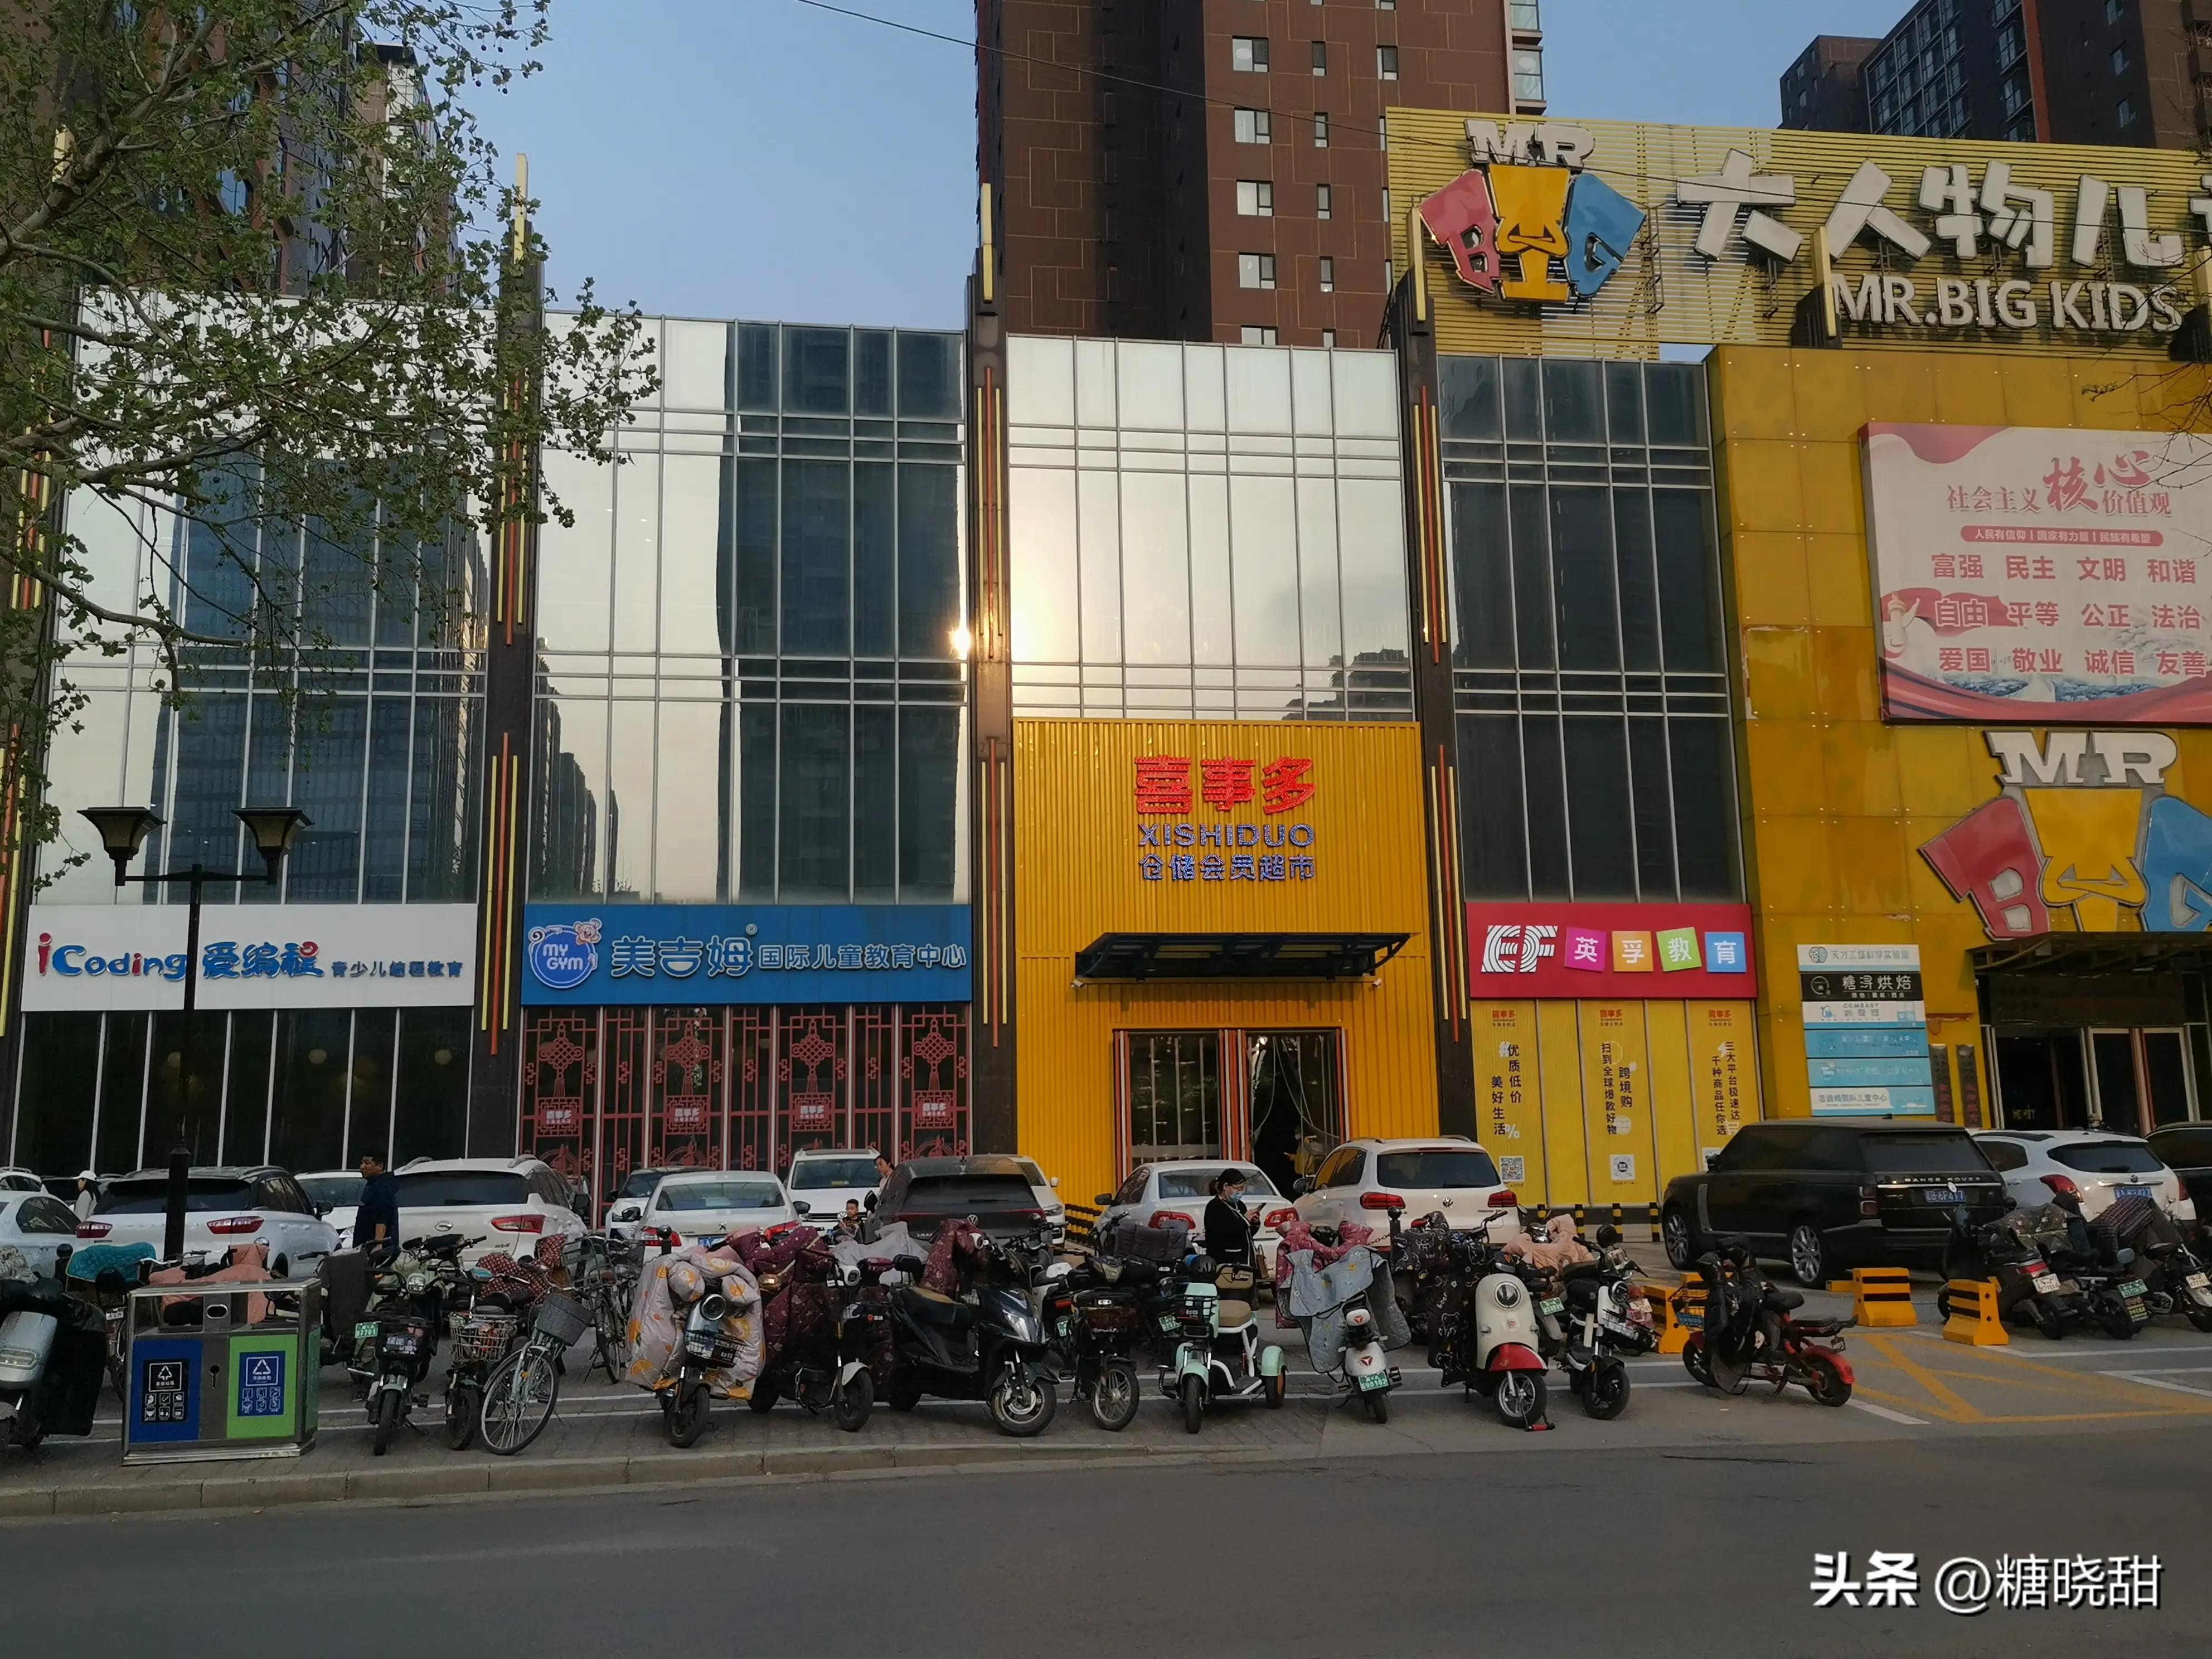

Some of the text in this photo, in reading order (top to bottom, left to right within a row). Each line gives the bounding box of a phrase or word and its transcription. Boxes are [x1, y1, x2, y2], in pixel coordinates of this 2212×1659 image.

[1464, 119, 1595, 171] MR
[1676, 148, 2212, 269] 大人物儿
[1832, 273, 2184, 332] MR.BIG KIDS
[1931, 553, 2196, 584] 富强 民主 文明 和谐
[1935, 599, 2201, 630] 自由 平等 公正 法治
[1939, 648, 2206, 676] 爱国 敬业 诚信 友善
[1134, 754, 1316, 814] 喜事多
[1984, 730, 2177, 787] MR
[1138, 823, 1314, 847] XISHIDUO
[1138, 853, 1314, 881] 仓储会员超市
[331, 961, 463, 978] 青少儿编程教育
[611, 935, 967, 978] 美吉姆 国际儿童教育中心
[1481, 925, 1738, 973] EF 英孚教育
[1507, 1044, 1522, 1104] 优质低价
[1711, 1055, 1727, 1136] 千种商品任你选
[1725, 1041, 1740, 1120] 三大平台极速达
[1491, 1075, 1506, 1136] 美好生活
